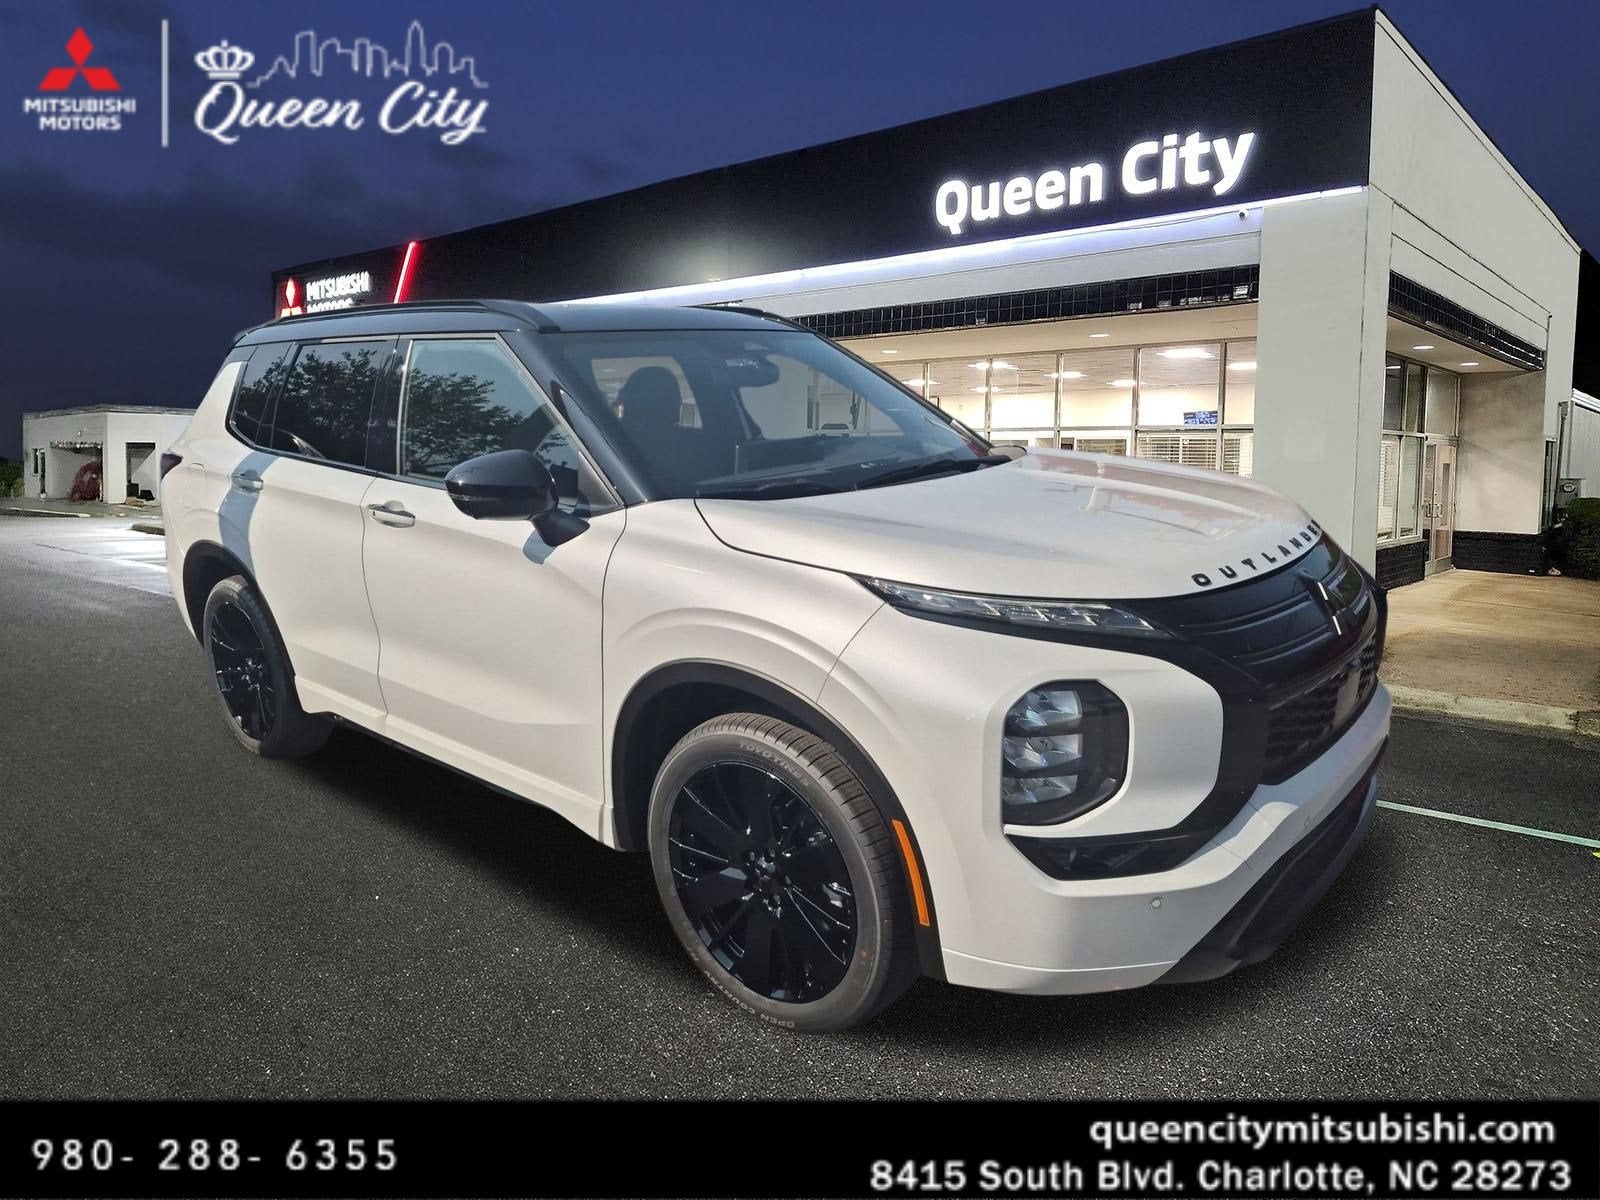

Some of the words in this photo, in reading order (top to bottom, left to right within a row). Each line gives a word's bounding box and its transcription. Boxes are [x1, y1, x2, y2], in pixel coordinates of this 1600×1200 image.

[935, 161, 1104, 235] Queen
[1121, 131, 1256, 196] City
[306, 270, 370, 302] MITSUBISHI
